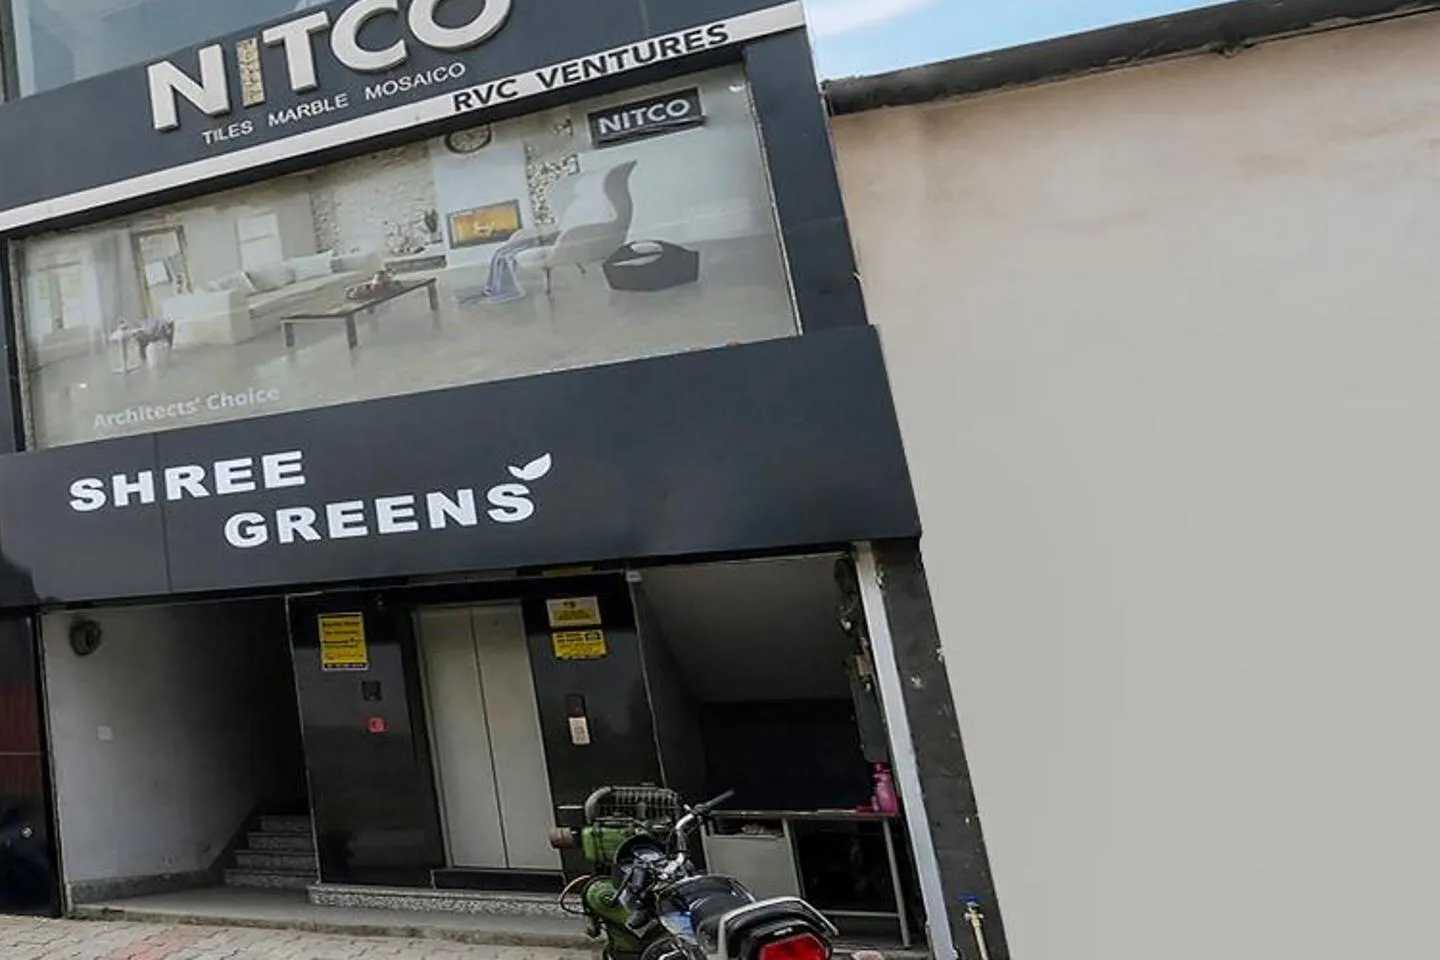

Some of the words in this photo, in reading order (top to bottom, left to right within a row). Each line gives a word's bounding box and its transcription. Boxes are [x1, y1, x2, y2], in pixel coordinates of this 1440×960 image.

[452, 78, 518, 113] RVC
[534, 23, 730, 90] VENTURES
[201, 120, 254, 146] TILES
[267, 93, 350, 128] MARBLE
[364, 62, 467, 101] MOSAICO
[598, 99, 691, 134] NITCO
[206, 385, 281, 411] Choice
[68, 450, 306, 512] SHREE
[224, 482, 536, 549] GREENS
